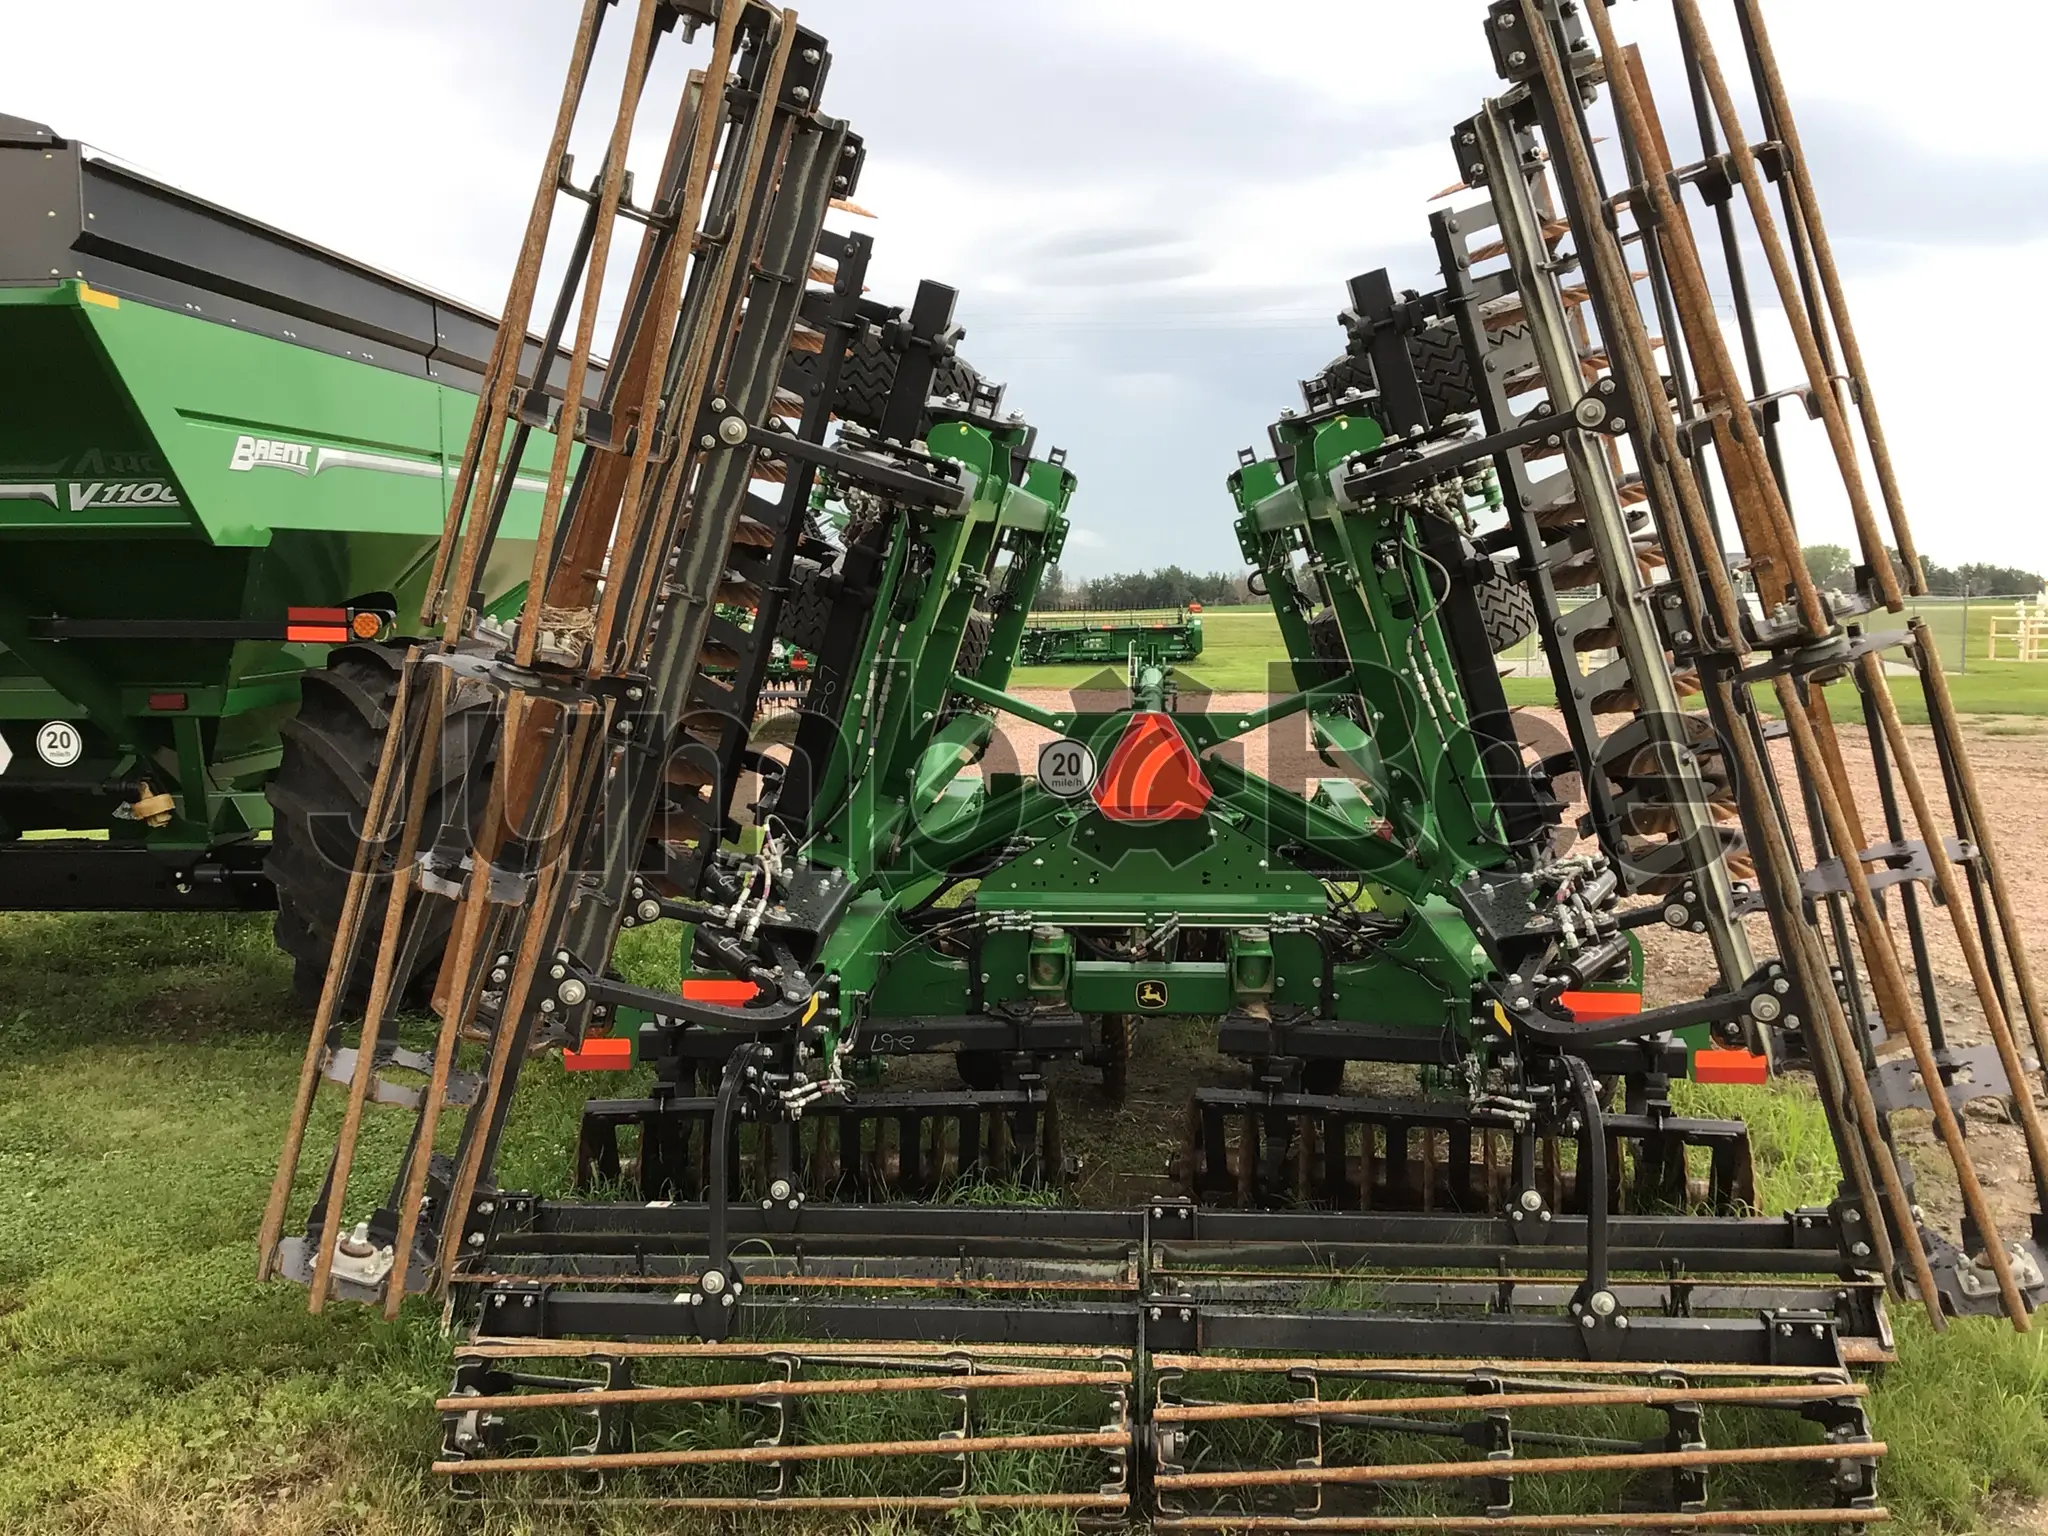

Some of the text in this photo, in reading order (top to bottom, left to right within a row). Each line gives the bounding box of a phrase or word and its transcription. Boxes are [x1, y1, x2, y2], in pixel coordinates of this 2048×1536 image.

[46, 731, 71, 749] 20
[1052, 753, 1080, 776] 20
[1052, 778, 1082, 787] mile/h
